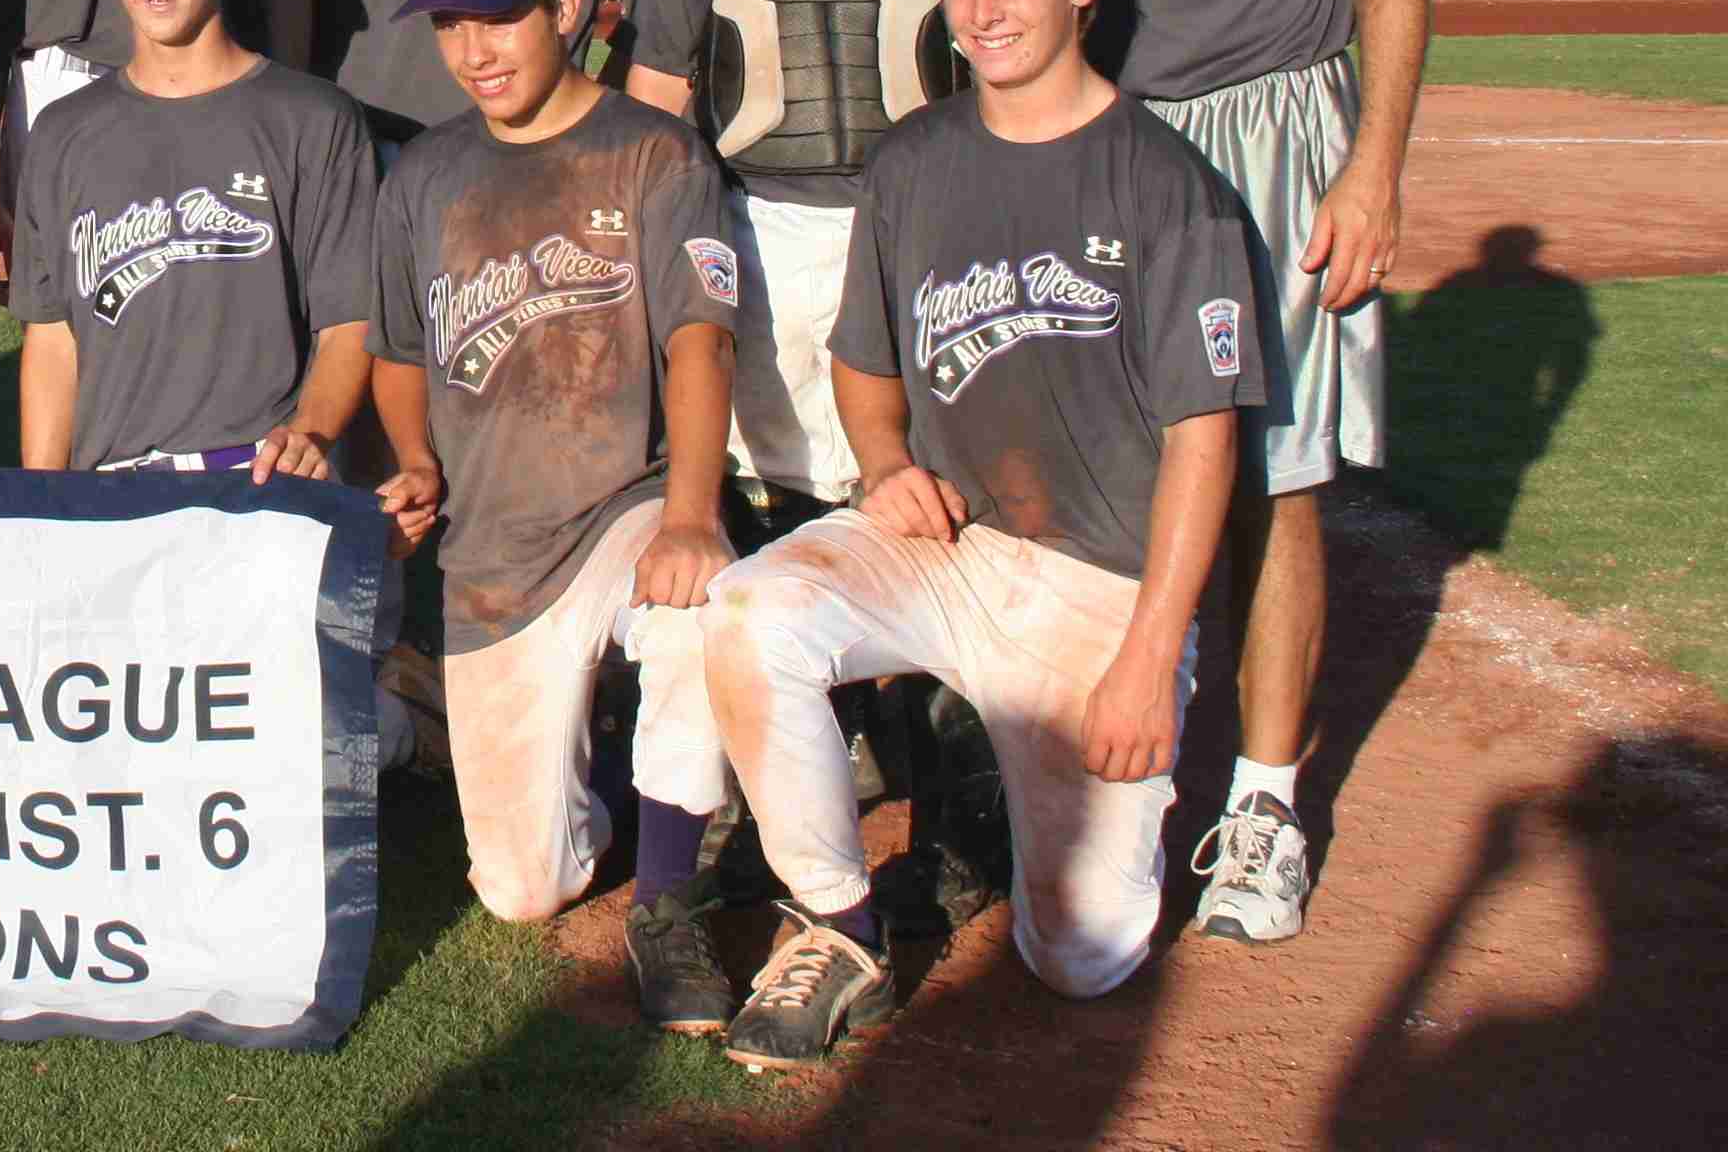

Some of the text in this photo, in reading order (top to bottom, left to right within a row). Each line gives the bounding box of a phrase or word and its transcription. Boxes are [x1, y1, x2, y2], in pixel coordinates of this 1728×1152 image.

[176, 189, 251, 234] View
[113, 264, 147, 297] ALL
[534, 236, 617, 287] View
[1022, 254, 1109, 304] View
[476, 325, 511, 360] ALL
[953, 334, 992, 371] ALL
[198, 790, 250, 870] 6
